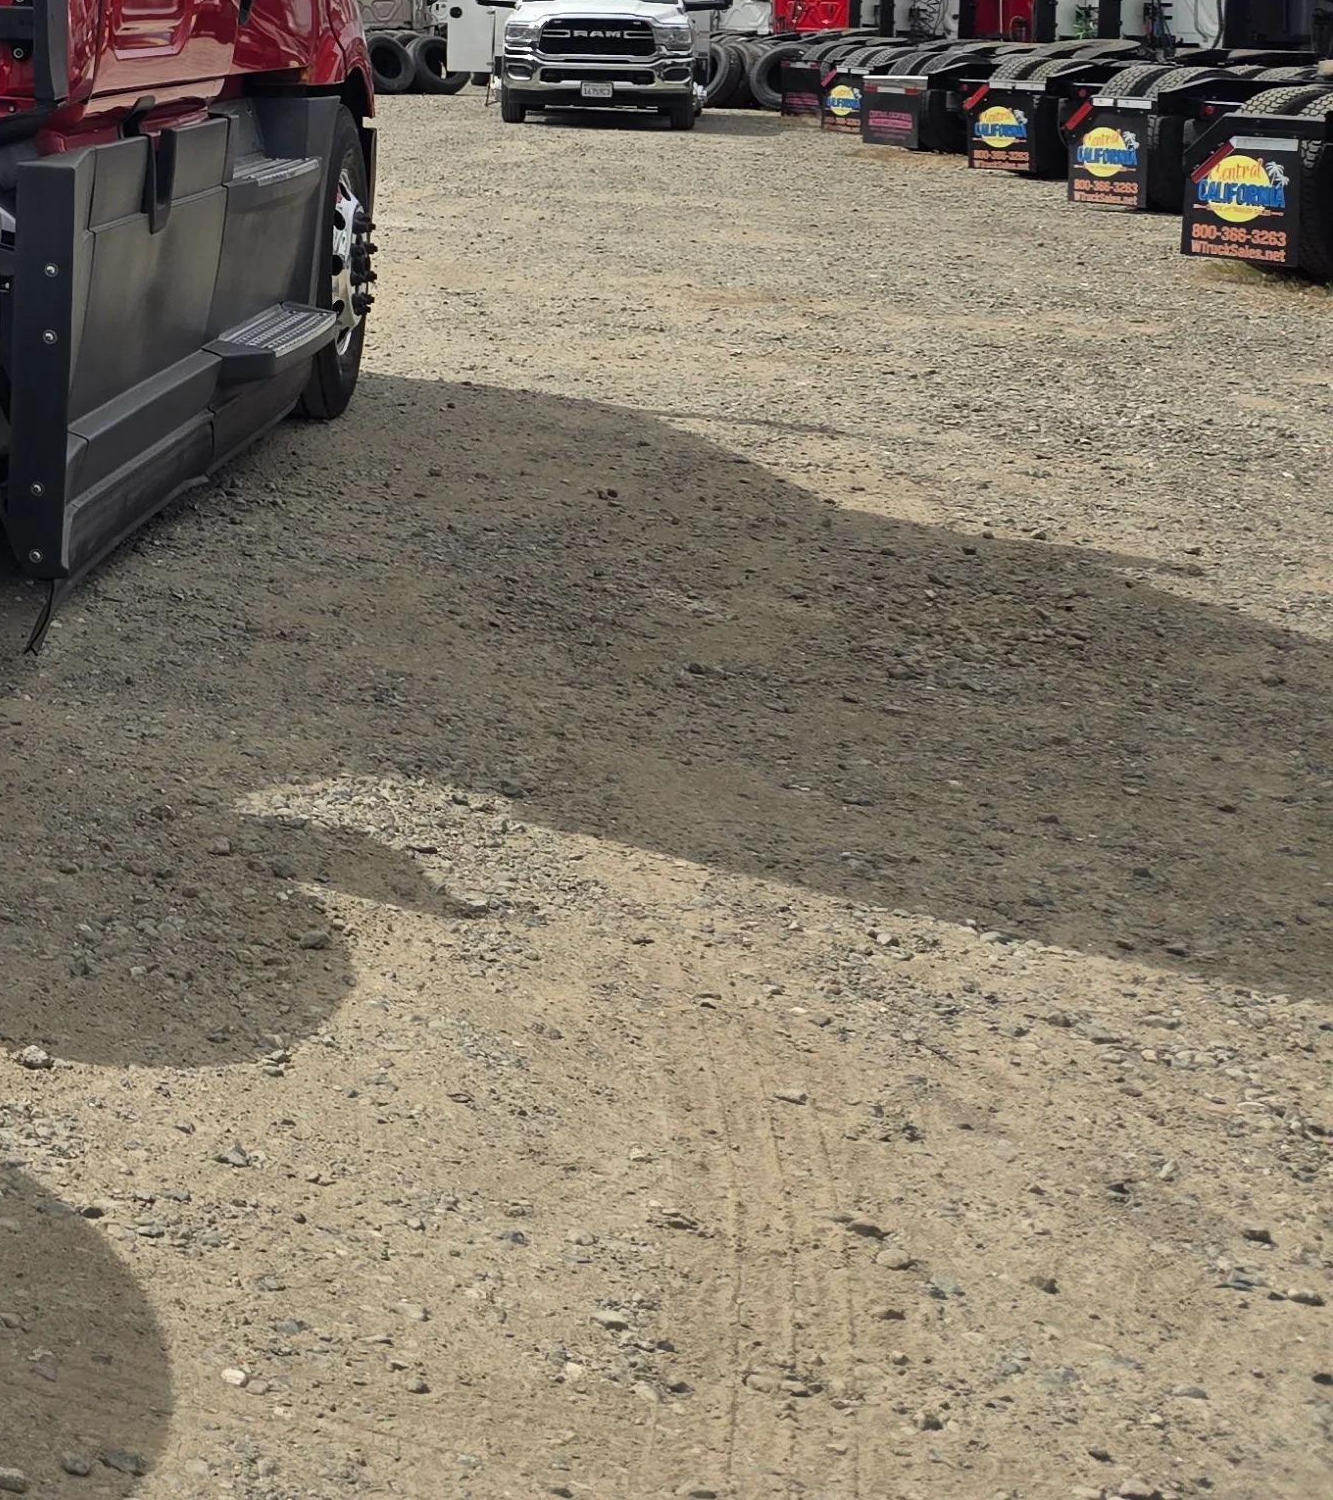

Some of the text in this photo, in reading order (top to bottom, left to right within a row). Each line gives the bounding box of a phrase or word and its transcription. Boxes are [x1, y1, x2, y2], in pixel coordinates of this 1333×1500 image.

[573, 30, 621, 38] RAM
[1076, 145, 1137, 166] CALIFORNIA
[1197, 179, 1286, 208] CALIFORNIA
[1191, 223, 1287, 247] 800-366-3263
[1191, 239, 1286, 263] WTruckSales.net
